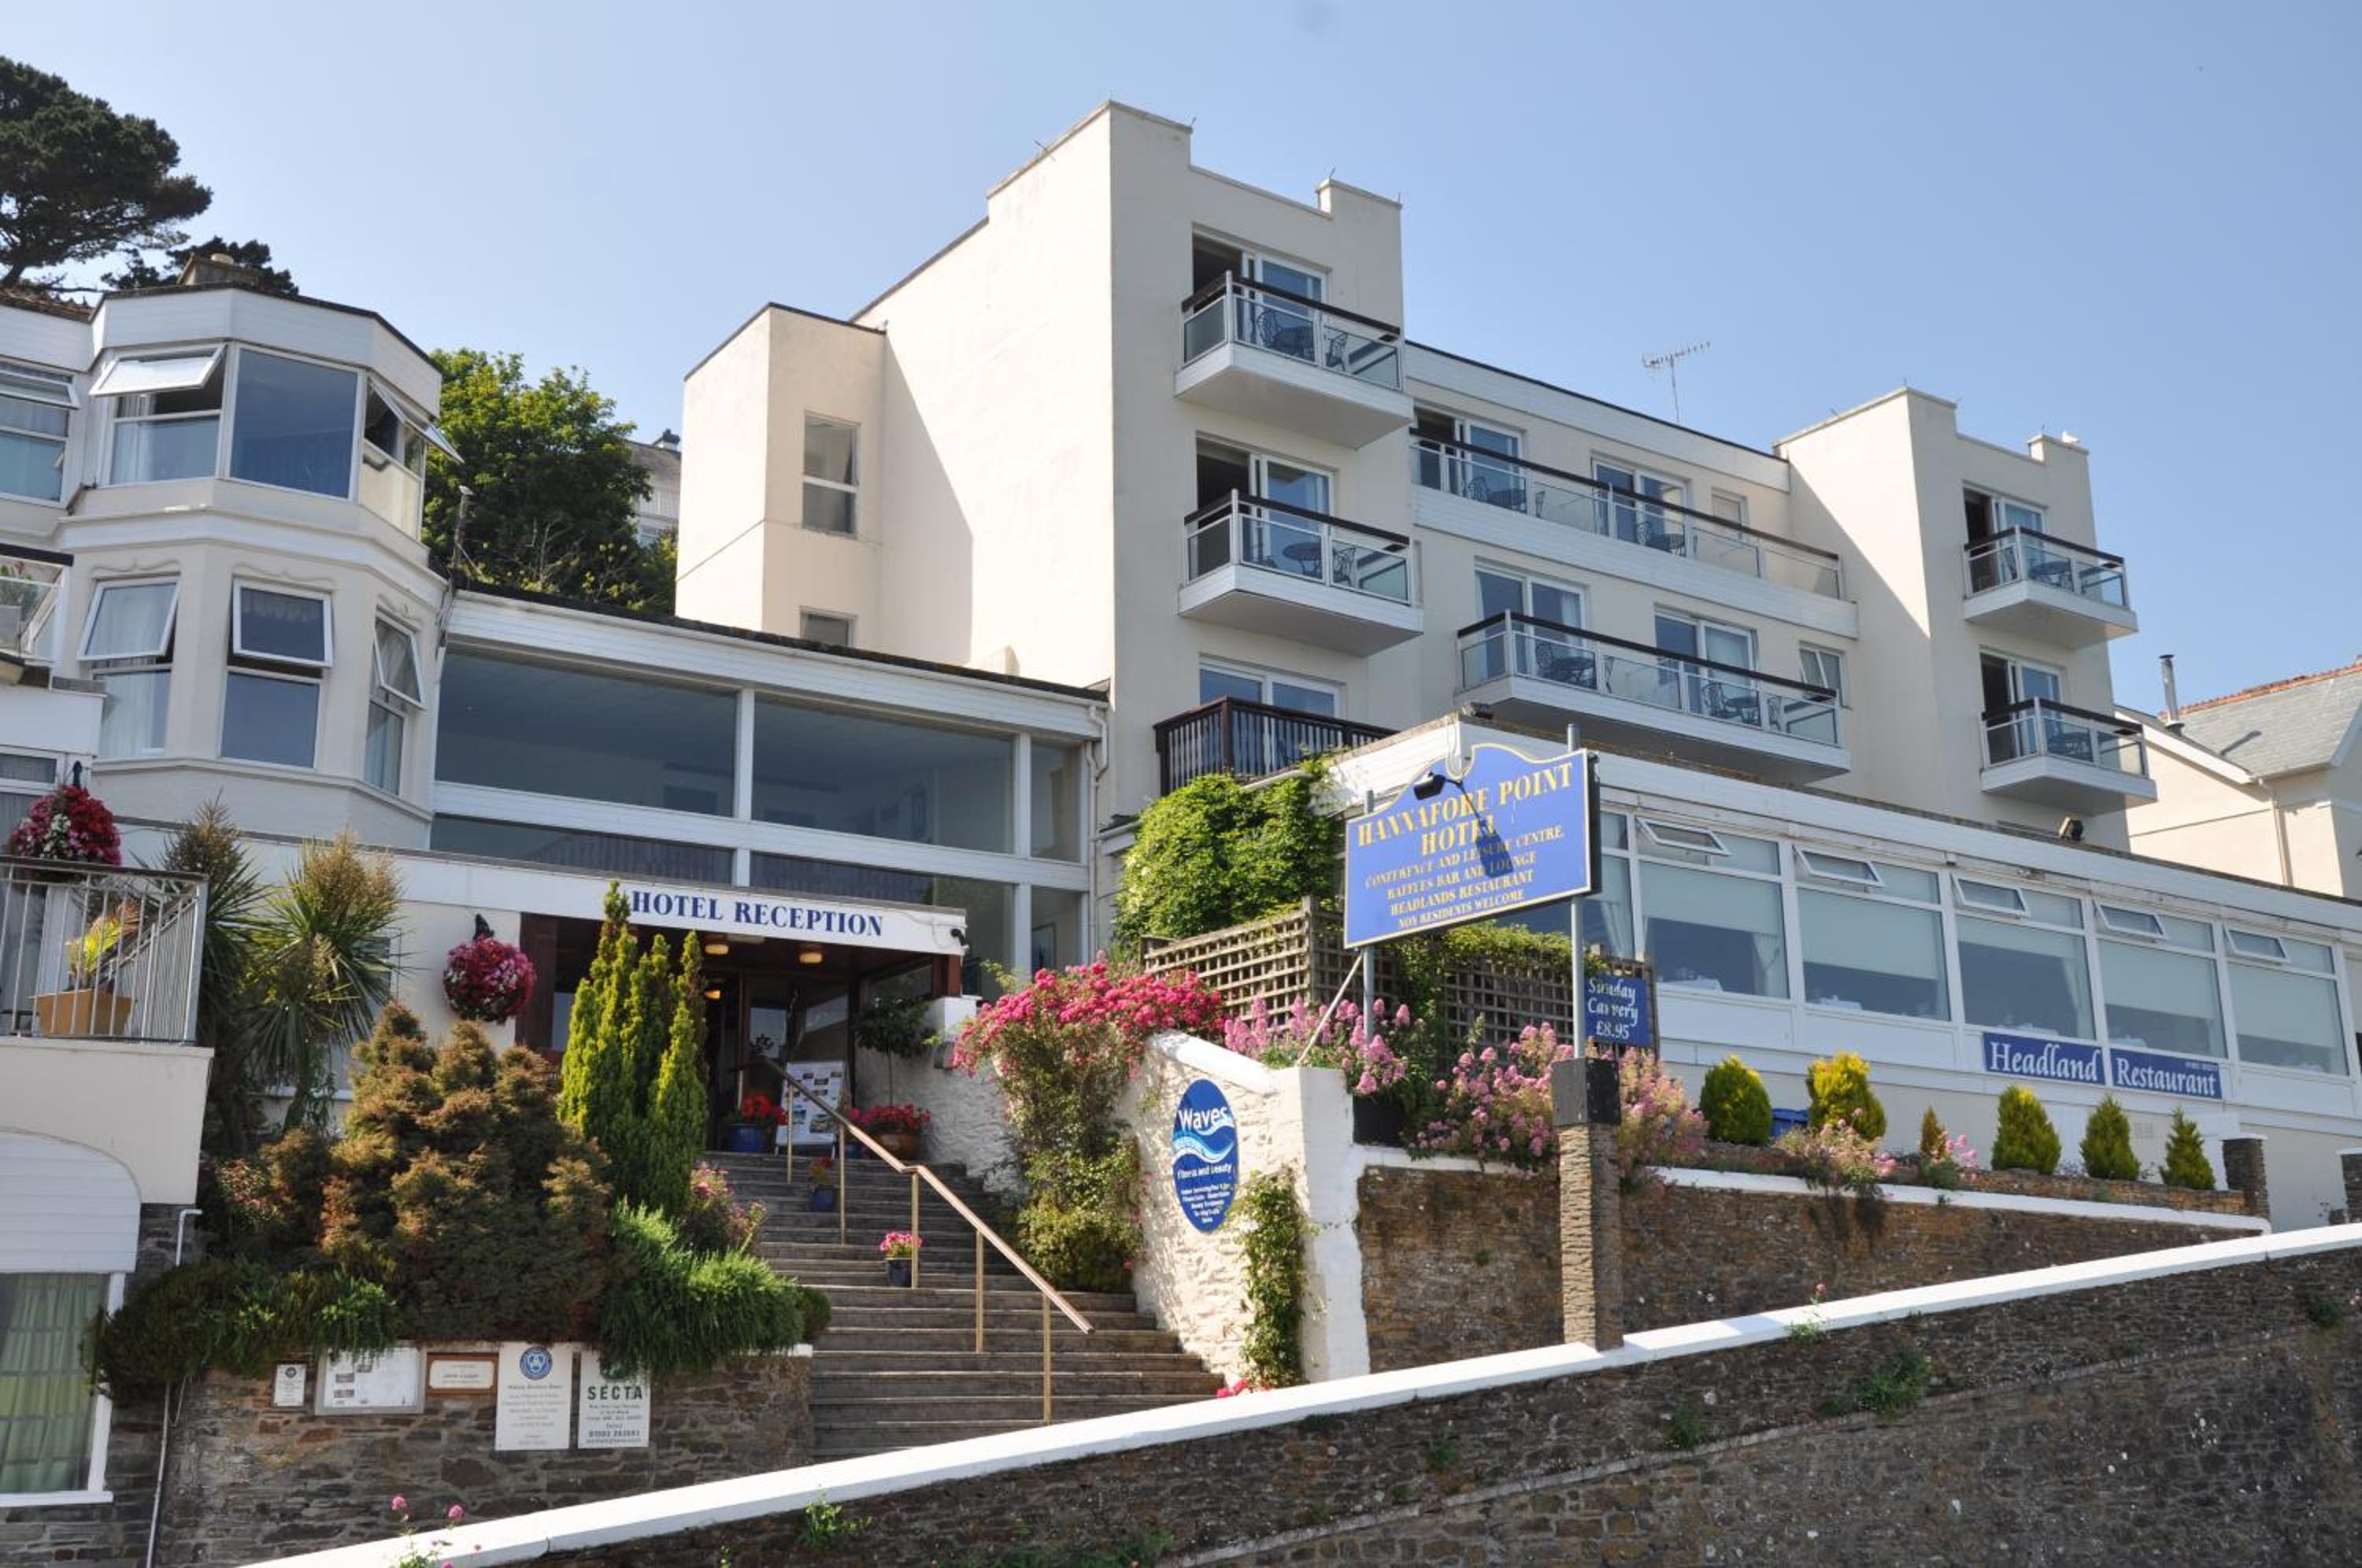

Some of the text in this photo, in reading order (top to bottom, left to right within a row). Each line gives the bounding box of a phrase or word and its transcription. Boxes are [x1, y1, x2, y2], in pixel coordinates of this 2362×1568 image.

[1357, 764, 1572, 847] HANNAFORE POINT
[1421, 815, 1495, 856] HOTEL
[1365, 861, 1433, 888] CONFERENCE
[1439, 852, 1460, 868] AND
[1516, 825, 1563, 846] CENTRE
[1436, 871, 1460, 887] BAR
[1465, 864, 1485, 879] AND
[1490, 850, 1537, 873] LOUNGE
[1390, 868, 1534, 916] HEADLANDS RESTAURANT
[1398, 889, 1524, 929] NON RESIDENTS WELCOME
[631, 890, 883, 937] HOTEL RECEPTION
[1588, 977, 1636, 1007] Sunday
[1588, 997, 1638, 1027] Carvery
[1596, 1020, 1630, 1040] £8.95
[1989, 1041, 2217, 1096] Headland Restaurant
[1179, 1106, 1228, 1131] Waves
[587, 1385, 642, 1400] SECTA
